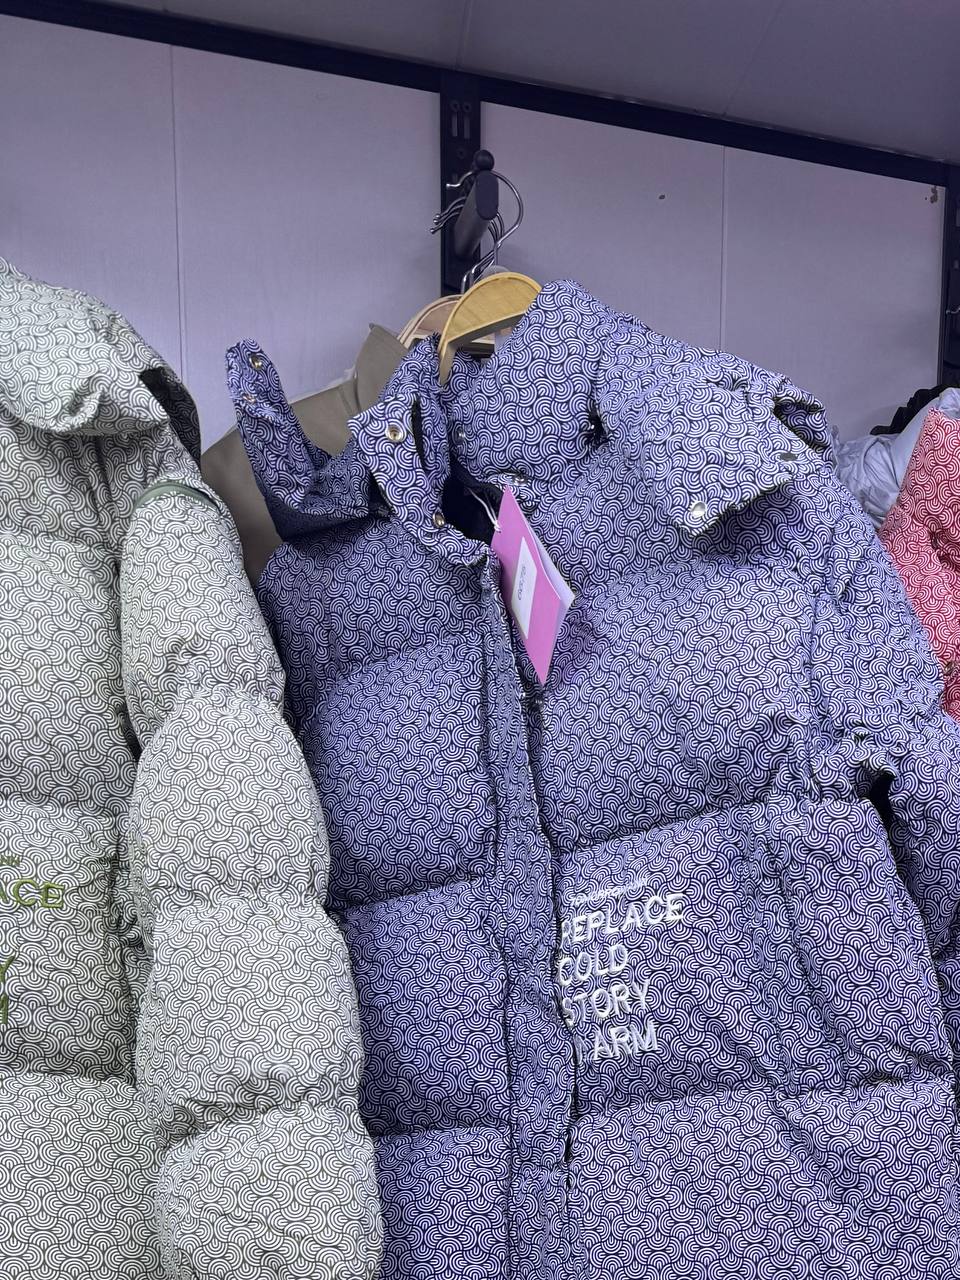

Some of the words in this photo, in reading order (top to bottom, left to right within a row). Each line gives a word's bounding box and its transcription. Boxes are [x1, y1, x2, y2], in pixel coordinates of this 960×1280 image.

[560, 893, 684, 949] REPLACE
[558, 943, 629, 986] COLD
[561, 979, 650, 1029] STORY
